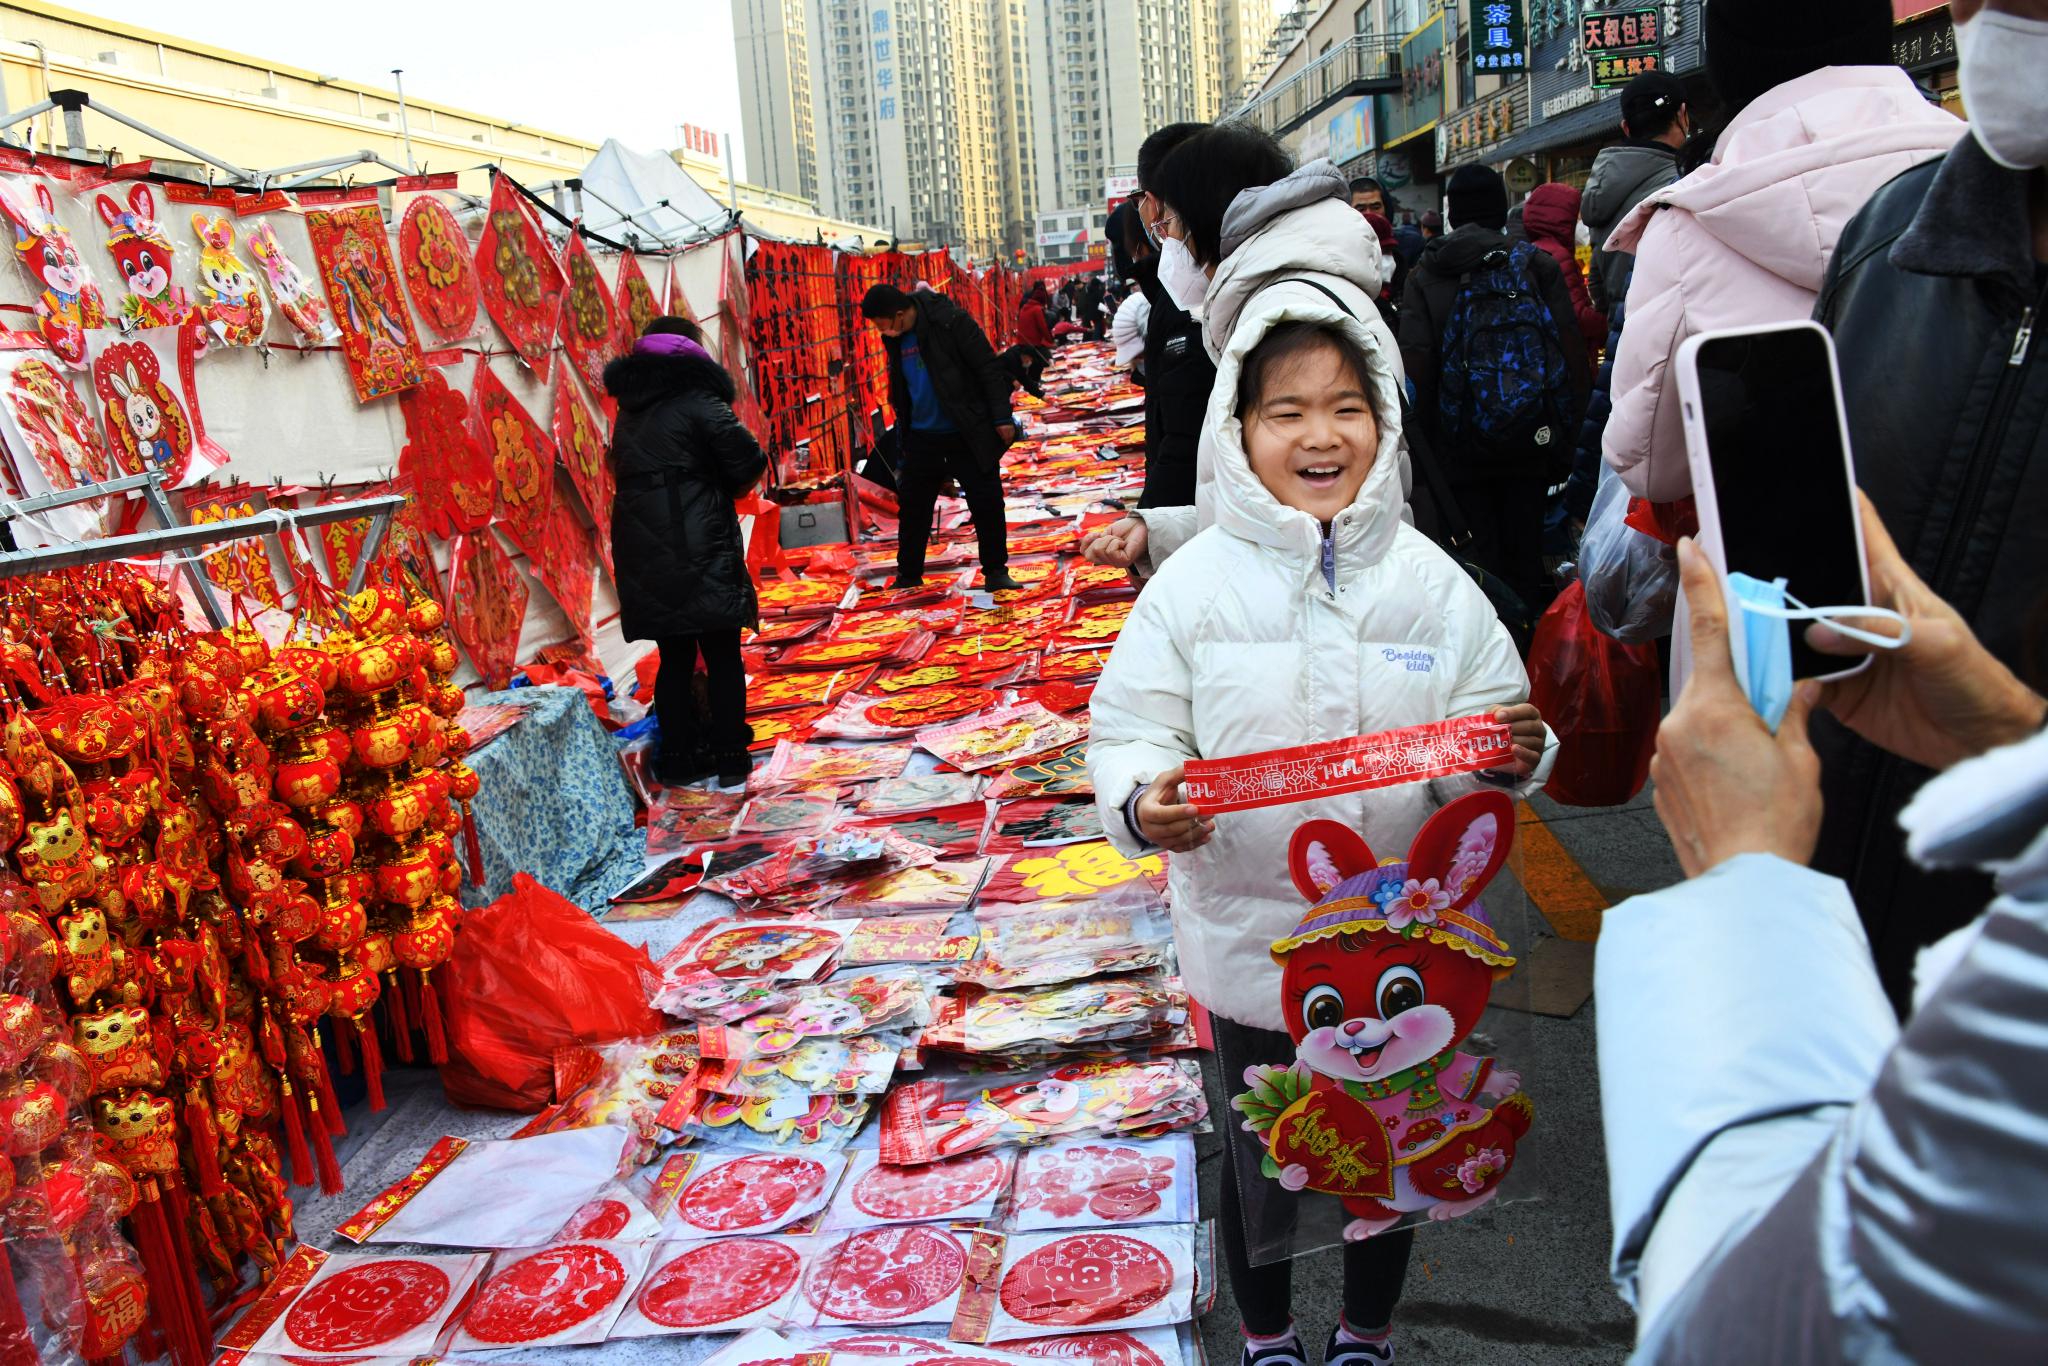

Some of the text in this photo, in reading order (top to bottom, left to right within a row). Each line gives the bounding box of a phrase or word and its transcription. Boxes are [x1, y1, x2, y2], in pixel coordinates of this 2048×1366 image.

[1484, 4, 1513, 48] 茶具
[872, 9, 895, 120] 鼎世华府
[1475, 53, 1523, 68] 专业批发
[100, 1287, 143, 1335] 福
